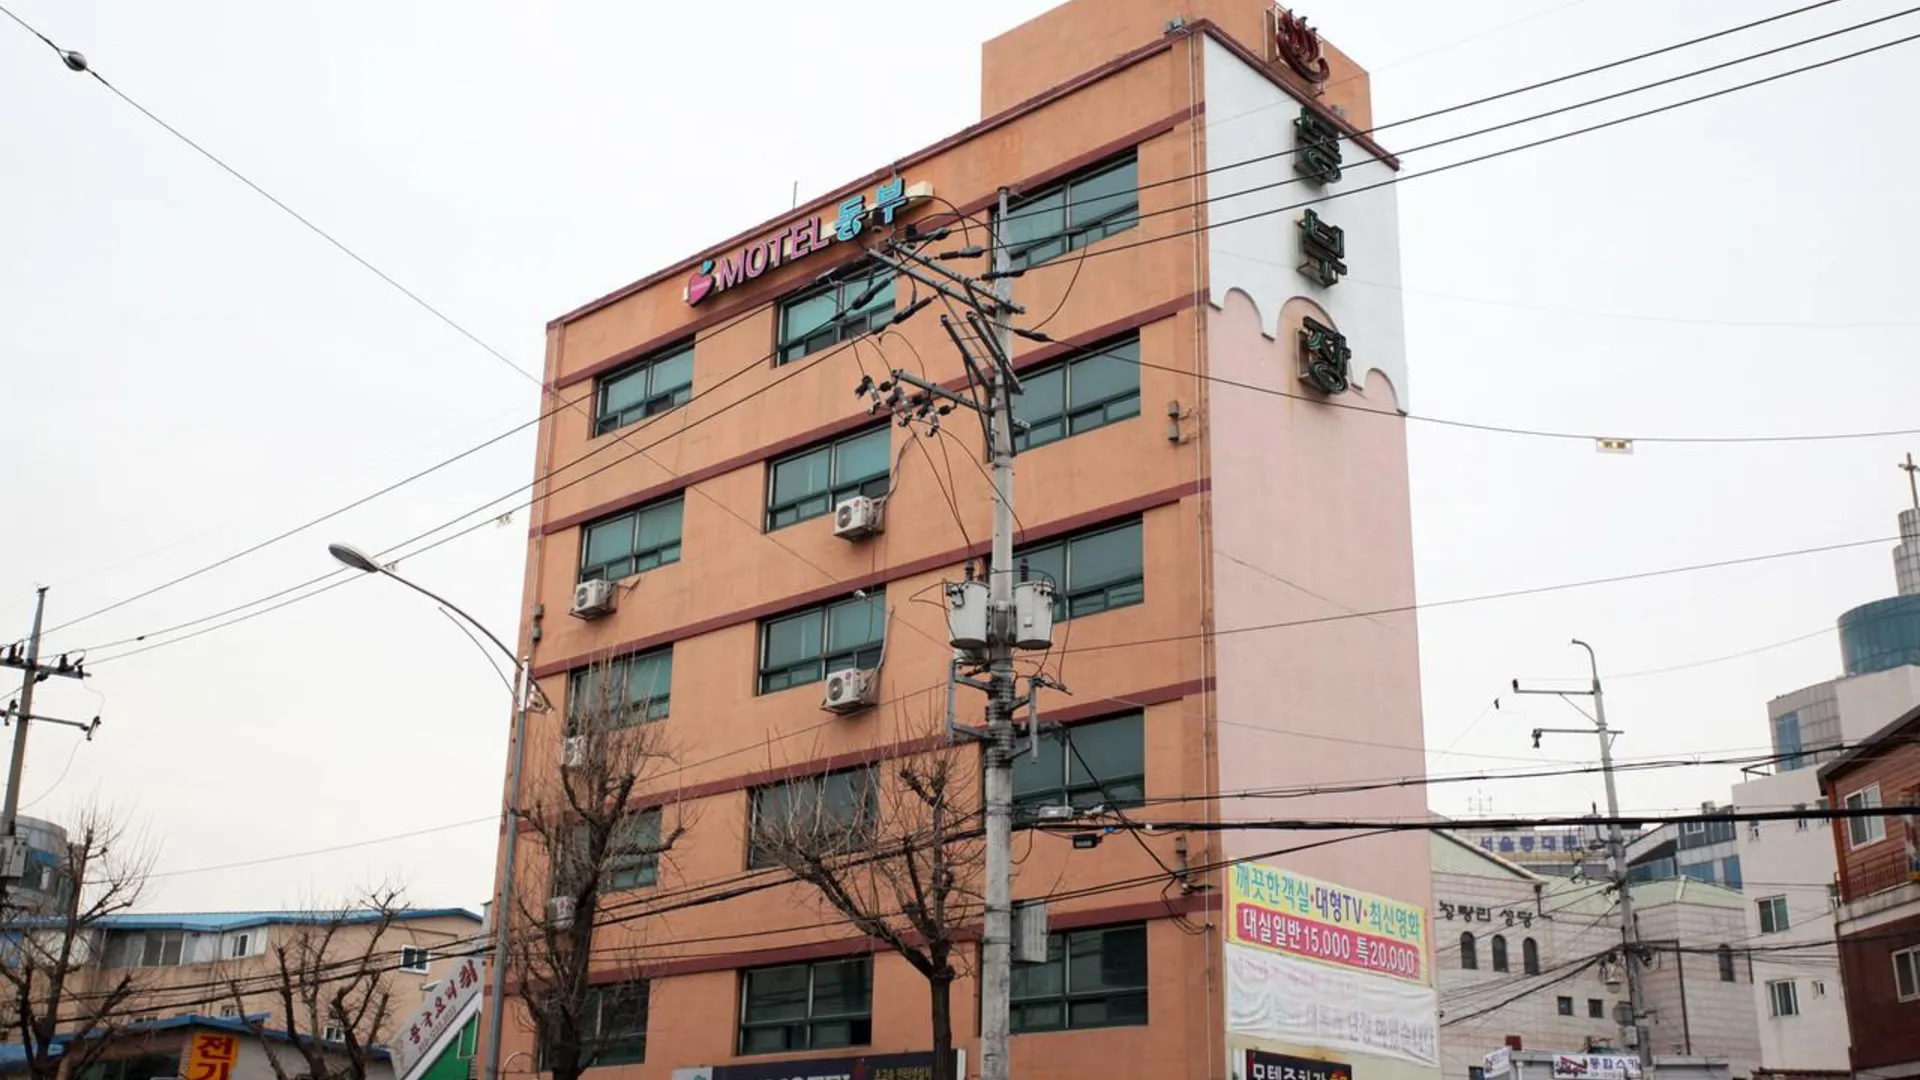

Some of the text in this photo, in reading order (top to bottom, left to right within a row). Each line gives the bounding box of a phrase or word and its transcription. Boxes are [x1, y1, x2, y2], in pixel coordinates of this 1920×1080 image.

[718, 177, 908, 293] MOTEL 동부
[1499, 908, 1533, 929] 성당
